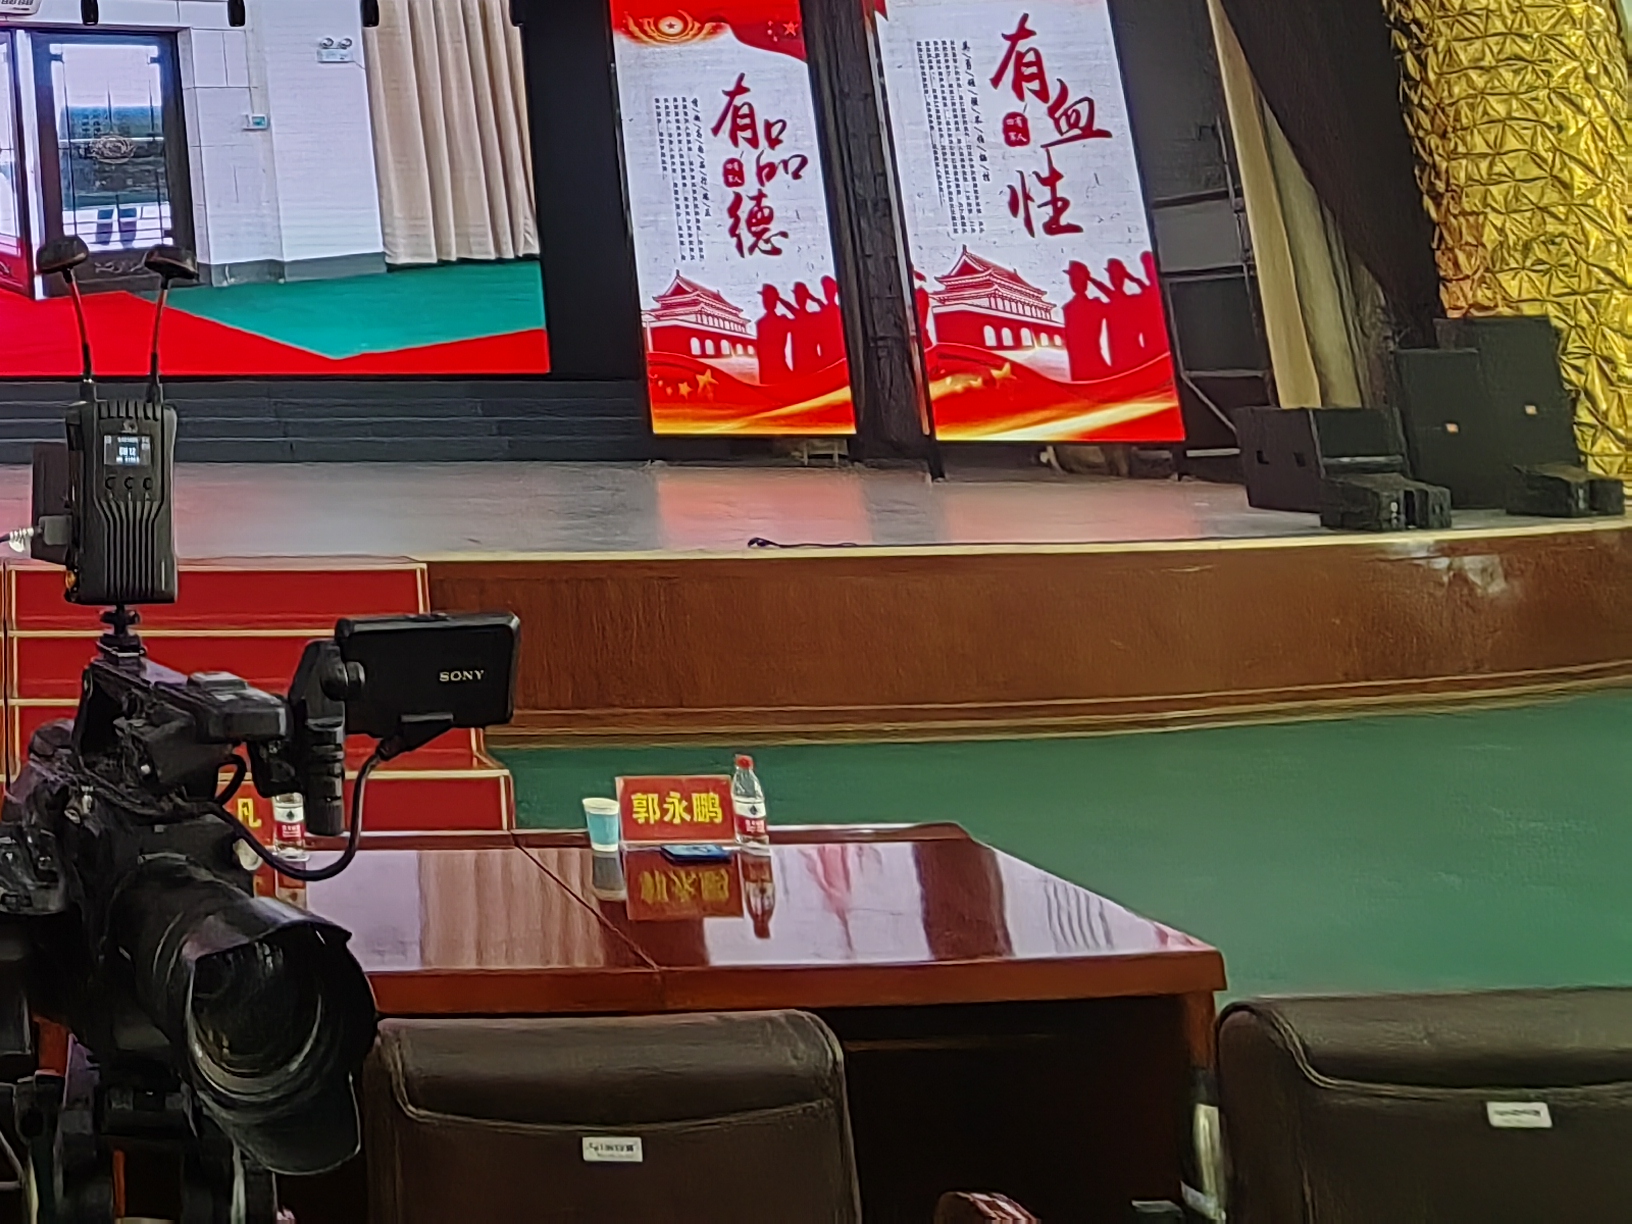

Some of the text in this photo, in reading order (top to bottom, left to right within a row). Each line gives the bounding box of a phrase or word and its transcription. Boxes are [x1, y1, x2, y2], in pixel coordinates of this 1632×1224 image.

[711, 72, 809, 259] 有品德
[989, 13, 1113, 238] 有血性
[439, 670, 485, 682] SONY
[631, 790, 723, 825] 郭永鹏
